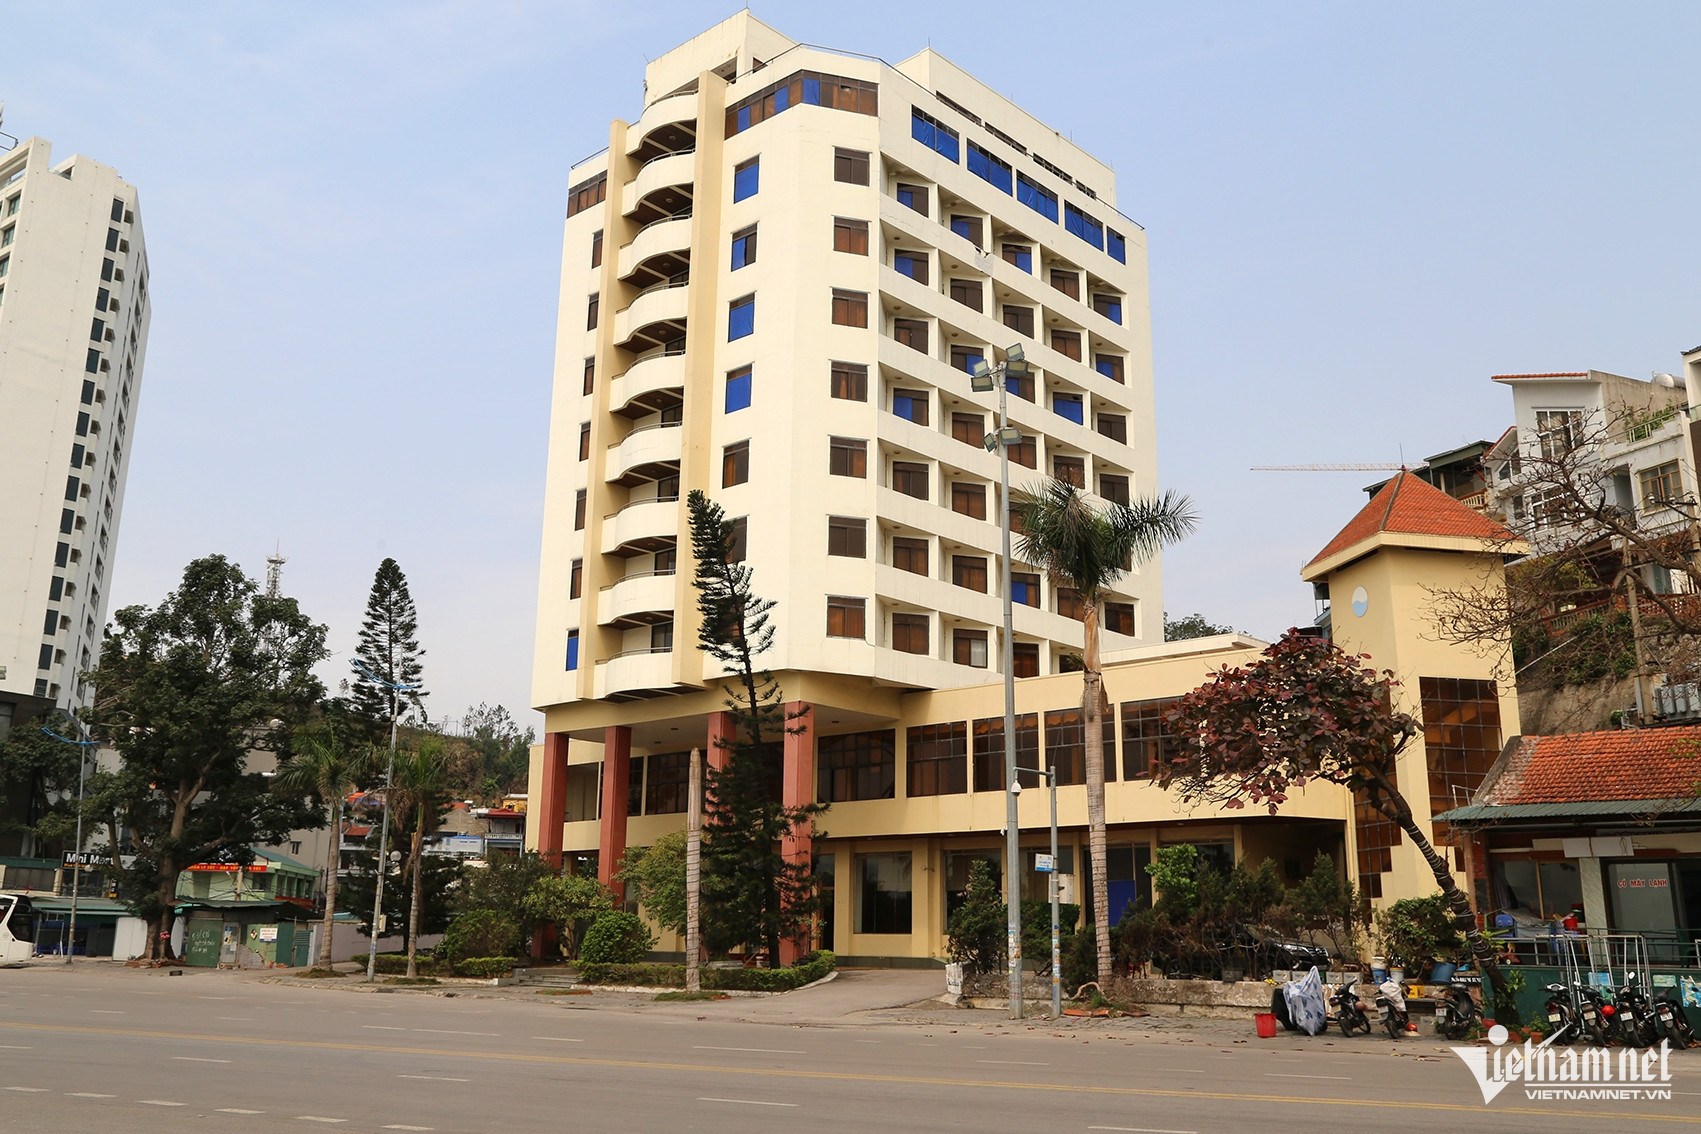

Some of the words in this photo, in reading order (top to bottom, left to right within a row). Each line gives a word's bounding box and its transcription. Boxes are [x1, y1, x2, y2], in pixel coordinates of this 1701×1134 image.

[66, 853, 87, 863] Mni
[1630, 879, 1645, 887] MÁY
[1649, 879, 1668, 888] LẠNH
